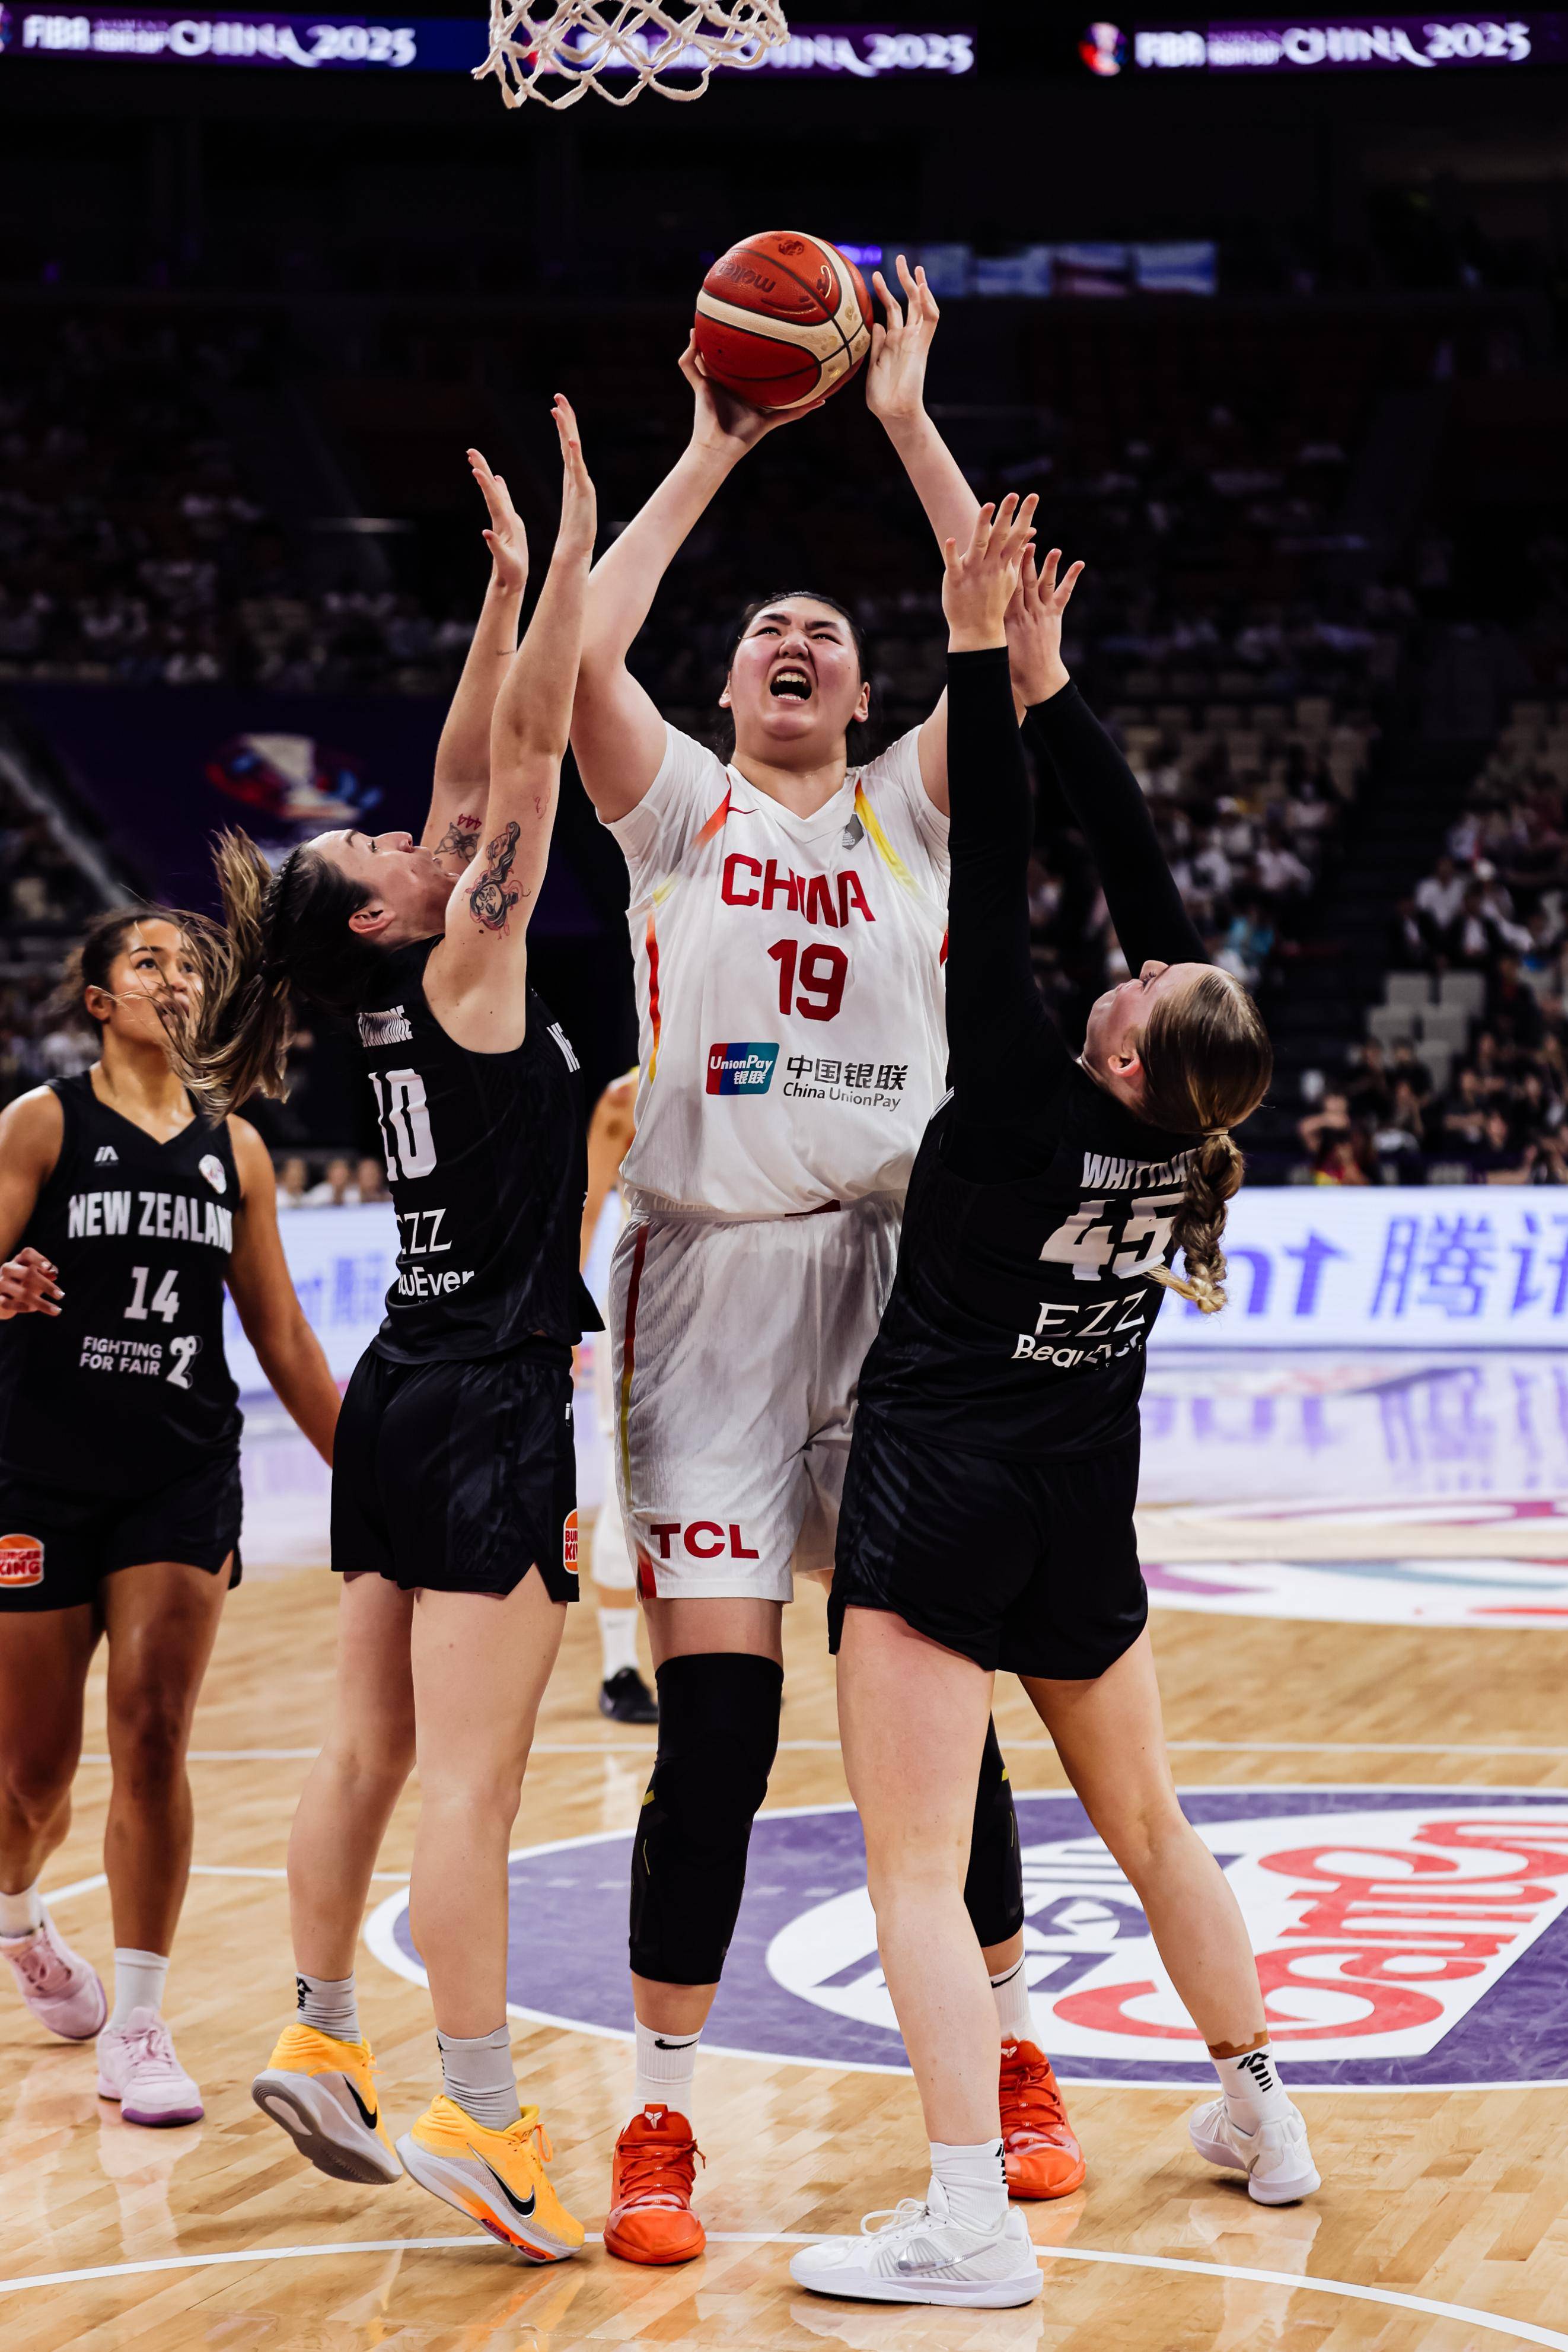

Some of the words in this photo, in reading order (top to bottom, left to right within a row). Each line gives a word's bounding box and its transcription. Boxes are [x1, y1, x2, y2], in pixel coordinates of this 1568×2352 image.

[167, 20, 321, 68] CHINA
[306, 24, 416, 68] 2025
[863, 33, 974, 75] 2025
[1282, 25, 1438, 68] CHINA
[1423, 21, 1531, 62] 2025
[721, 853, 876, 928] CHINA
[767, 939, 848, 1021] 19
[710, 1054, 773, 1074] UnionPay
[734, 1071, 767, 1085] 银联
[786, 1055, 909, 1090] 中国银联
[783, 1081, 826, 1099] China
[830, 1087, 901, 1112] UnionPay
[368, 1068, 437, 1182] 10
[68, 1191, 131, 1239] NEW
[1038, 1192, 1185, 1281] 45
[124, 1266, 180, 1323] 14
[1034, 1288, 1148, 1338] EZZ
[79, 1353, 114, 1371] FOR
[119, 1359, 161, 1376] FAIR
[83, 1336, 162, 1359] FIGHTING
[650, 1521, 760, 1559] TCL
